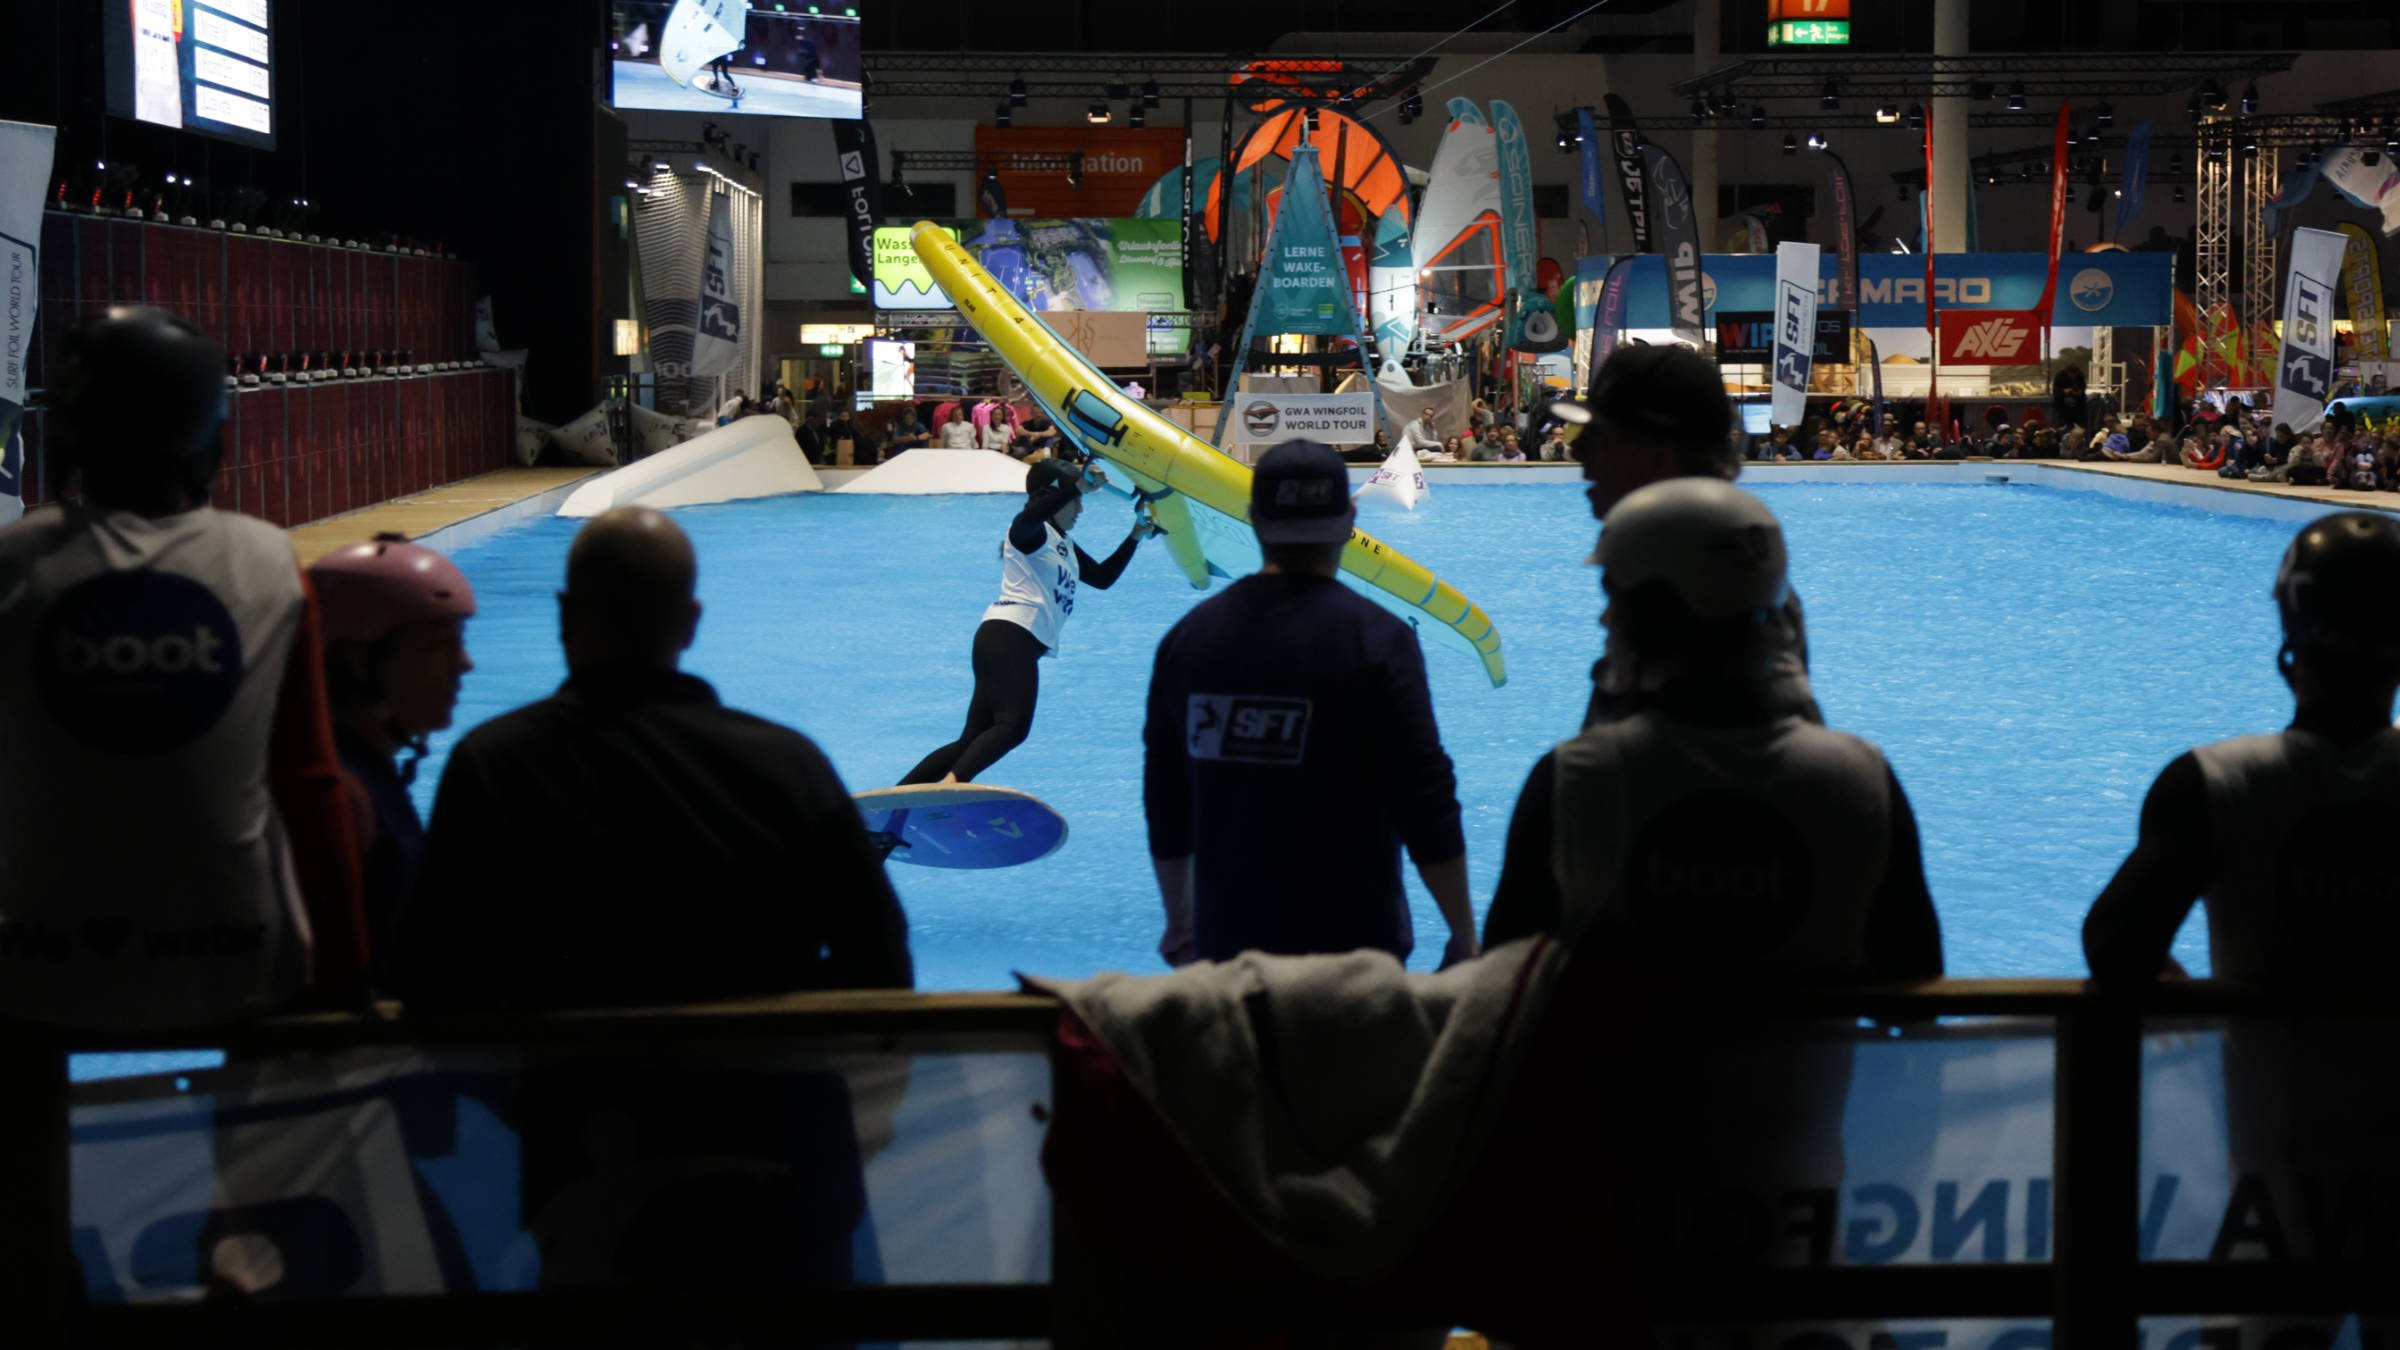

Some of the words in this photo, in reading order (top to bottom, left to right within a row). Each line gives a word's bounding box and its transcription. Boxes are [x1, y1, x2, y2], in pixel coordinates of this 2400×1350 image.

[1284, 246, 1325, 258] LERNE
[11, 252, 23, 284] TOUR
[1283, 262, 1327, 273] WAKE-
[1273, 277, 1336, 288] BOARDEN
[9, 286, 21, 332] WORLD
[1784, 286, 1801, 344] SFT
[2296, 279, 2319, 347] SFT
[8, 334, 20, 359] FOIL
[6, 359, 18, 390] SURF
[1285, 407, 1310, 416] GWA
[1313, 406, 1367, 416] WINGFOIL
[1285, 420, 1330, 430] WORLD
[1333, 420, 1367, 430] TOUR
[1380, 470, 1400, 481] SFT
[56, 624, 224, 675] boot
[1231, 706, 1305, 741] SFT
